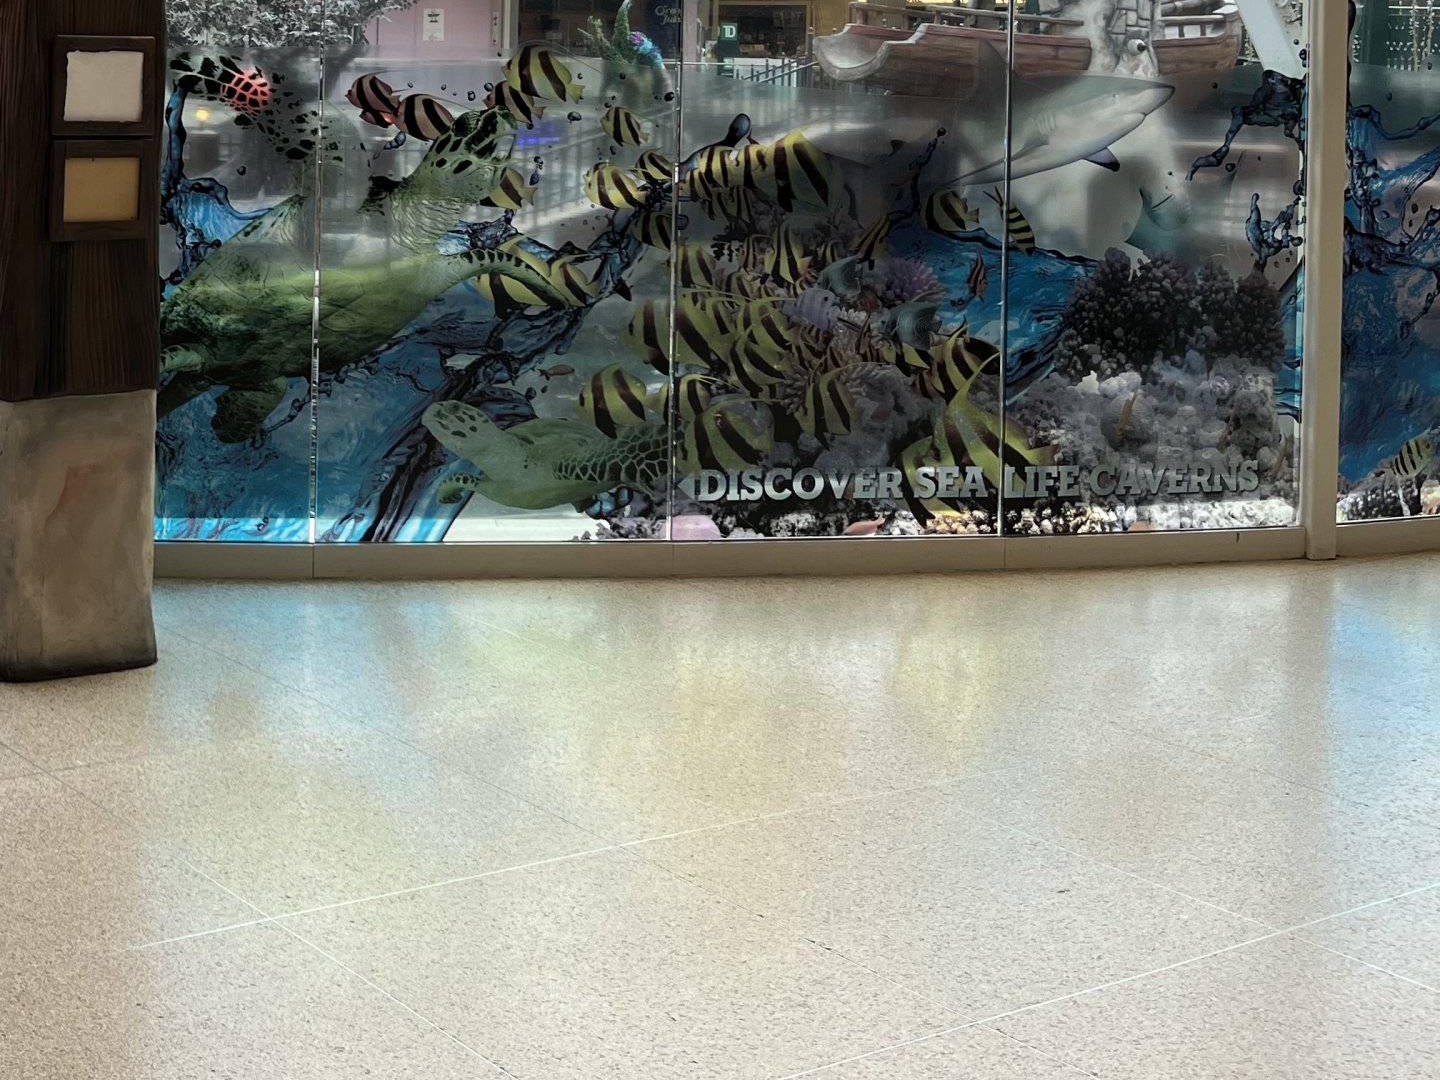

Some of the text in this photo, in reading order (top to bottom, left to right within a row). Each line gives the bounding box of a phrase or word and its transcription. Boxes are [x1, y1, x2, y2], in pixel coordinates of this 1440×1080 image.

[722, 25, 736, 38] TD
[698, 459, 1259, 501] DISCOVER SEA LIFE CAVERNS
